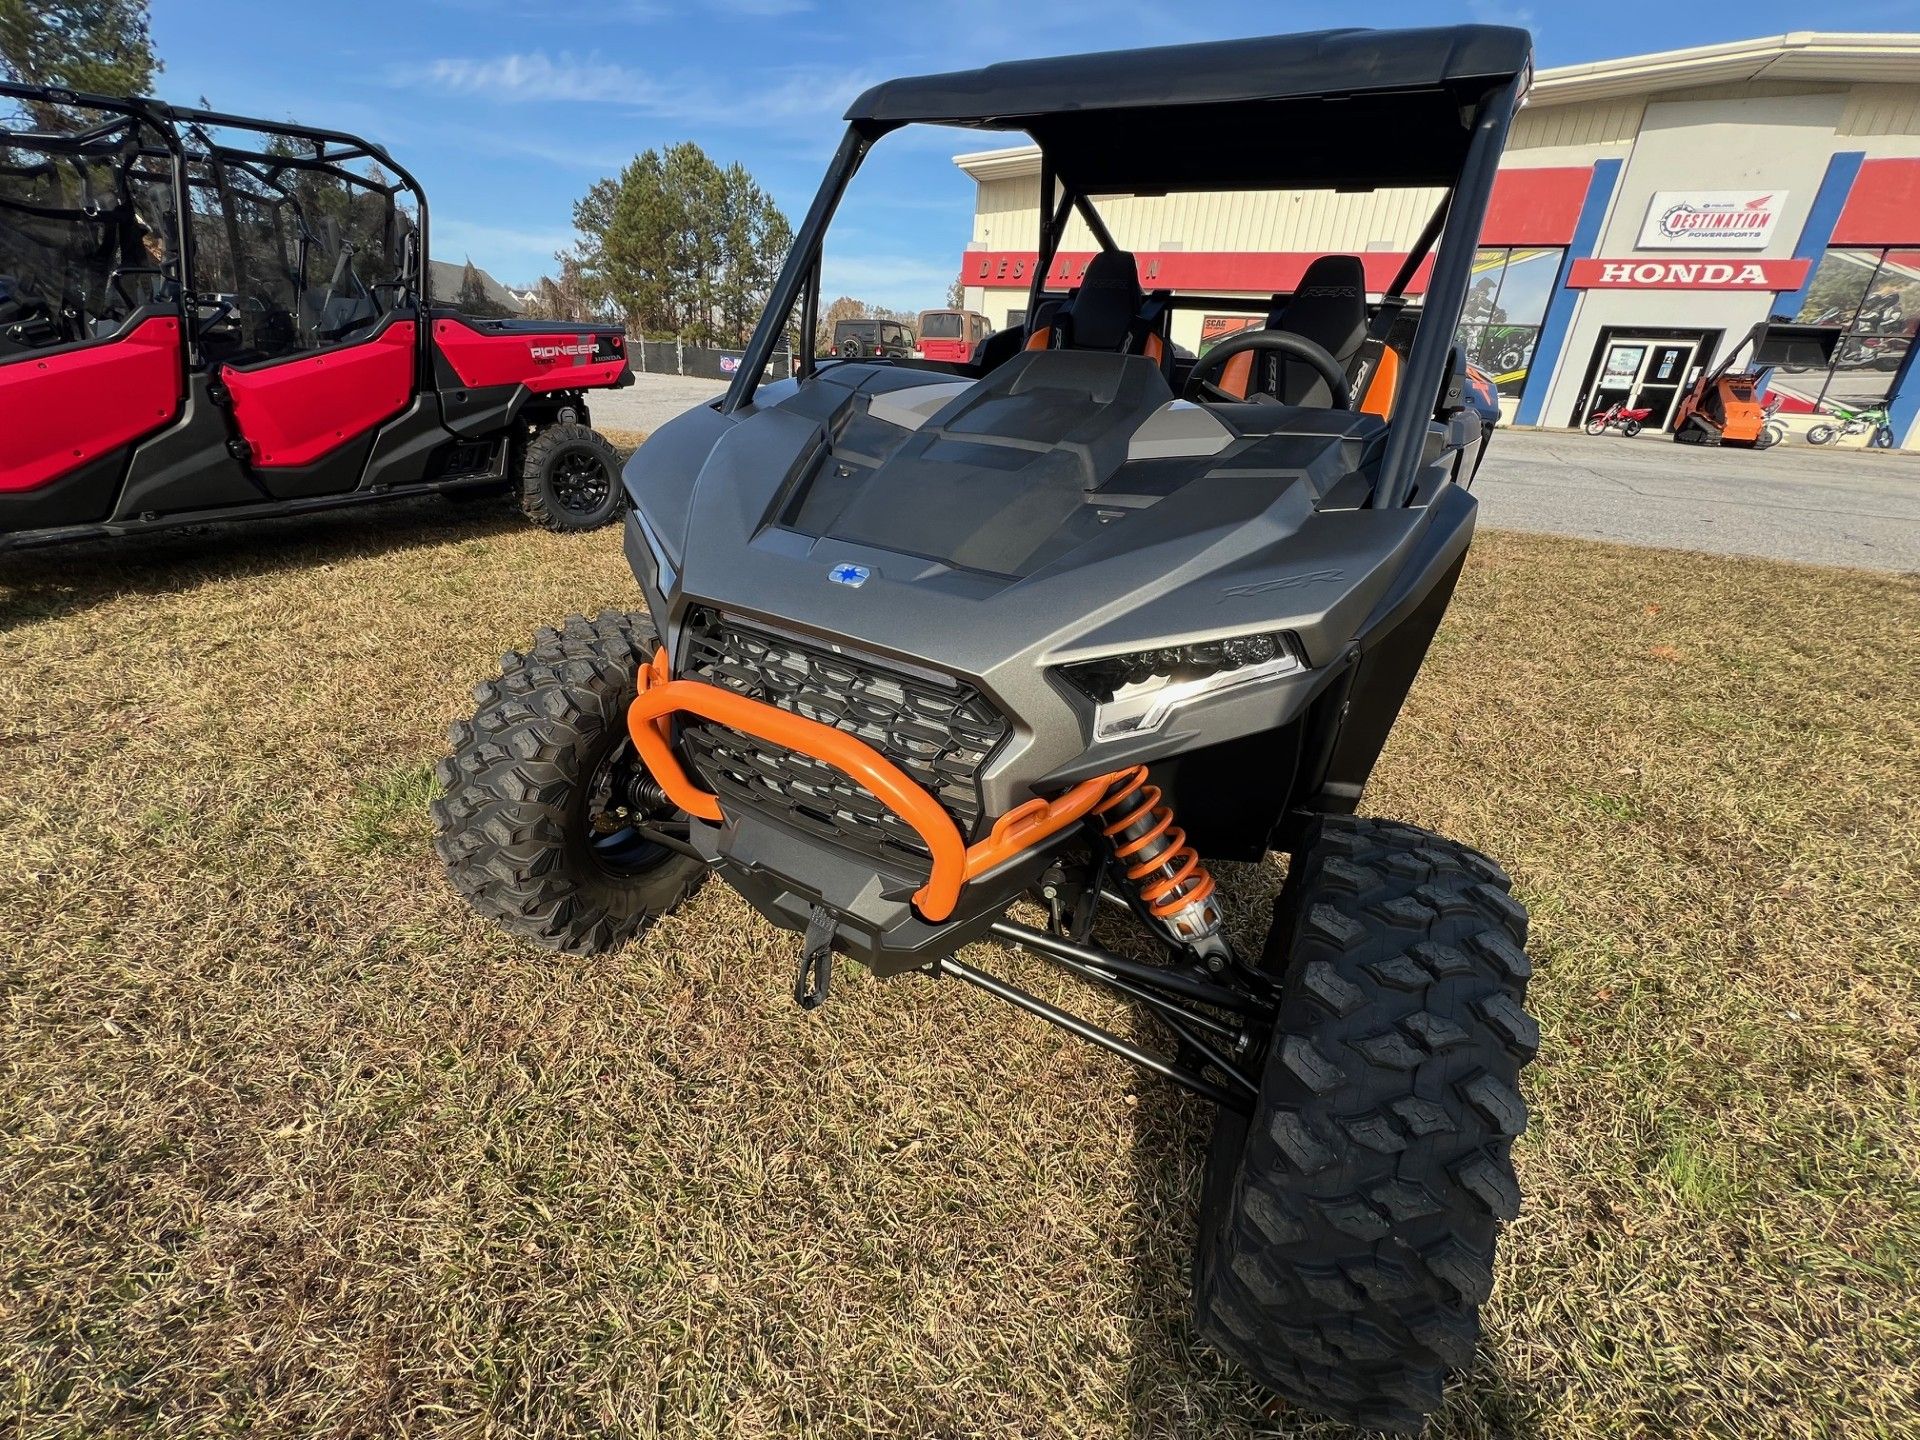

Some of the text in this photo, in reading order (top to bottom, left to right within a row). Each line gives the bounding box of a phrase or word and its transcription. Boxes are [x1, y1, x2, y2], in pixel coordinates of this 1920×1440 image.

[1670, 213, 1772, 229] DESTINATION
[1599, 264, 1768, 284] HONDA
[1206, 319, 1226, 327] SCAG
[530, 344, 600, 359] PIONEER
[595, 354, 621, 362] HONDA
[1268, 355, 1277, 392] RZR
[1348, 360, 1369, 400] RZR
[1215, 568, 1345, 605] RZR
